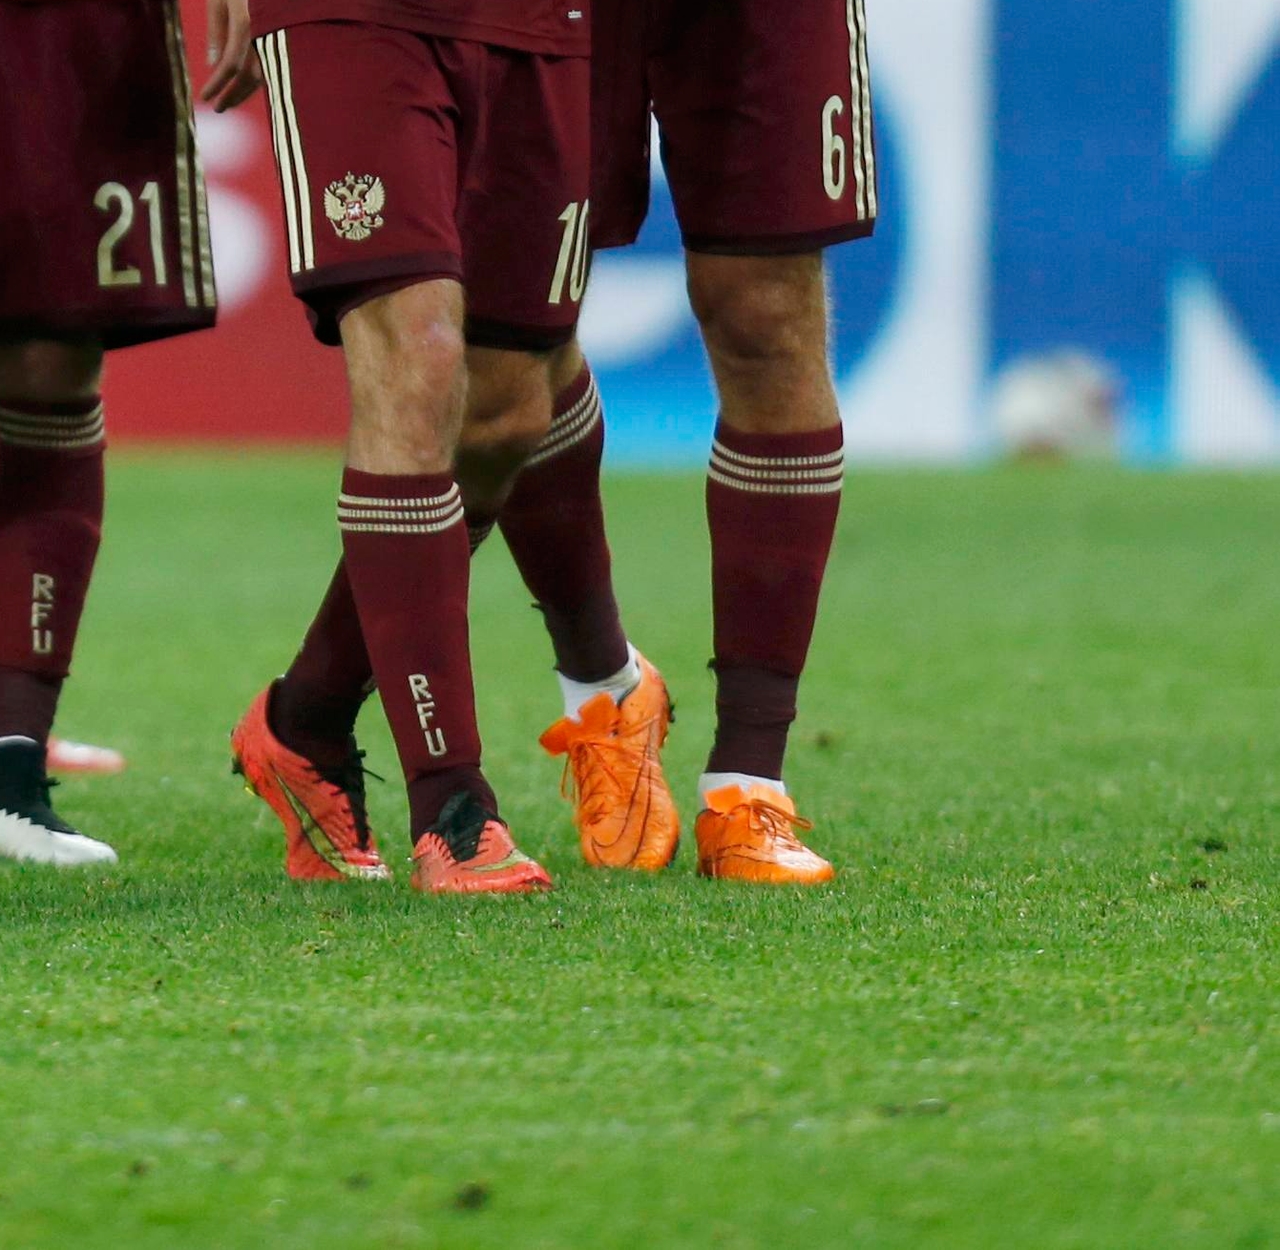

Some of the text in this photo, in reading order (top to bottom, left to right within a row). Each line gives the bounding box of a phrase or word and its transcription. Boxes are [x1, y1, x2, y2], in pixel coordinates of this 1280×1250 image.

[822, 95, 845, 201] 6
[93, 181, 167, 286] 21
[548, 198, 589, 305] 10
[31, 573, 54, 654] RFU
[408, 674, 448, 756] RFU
